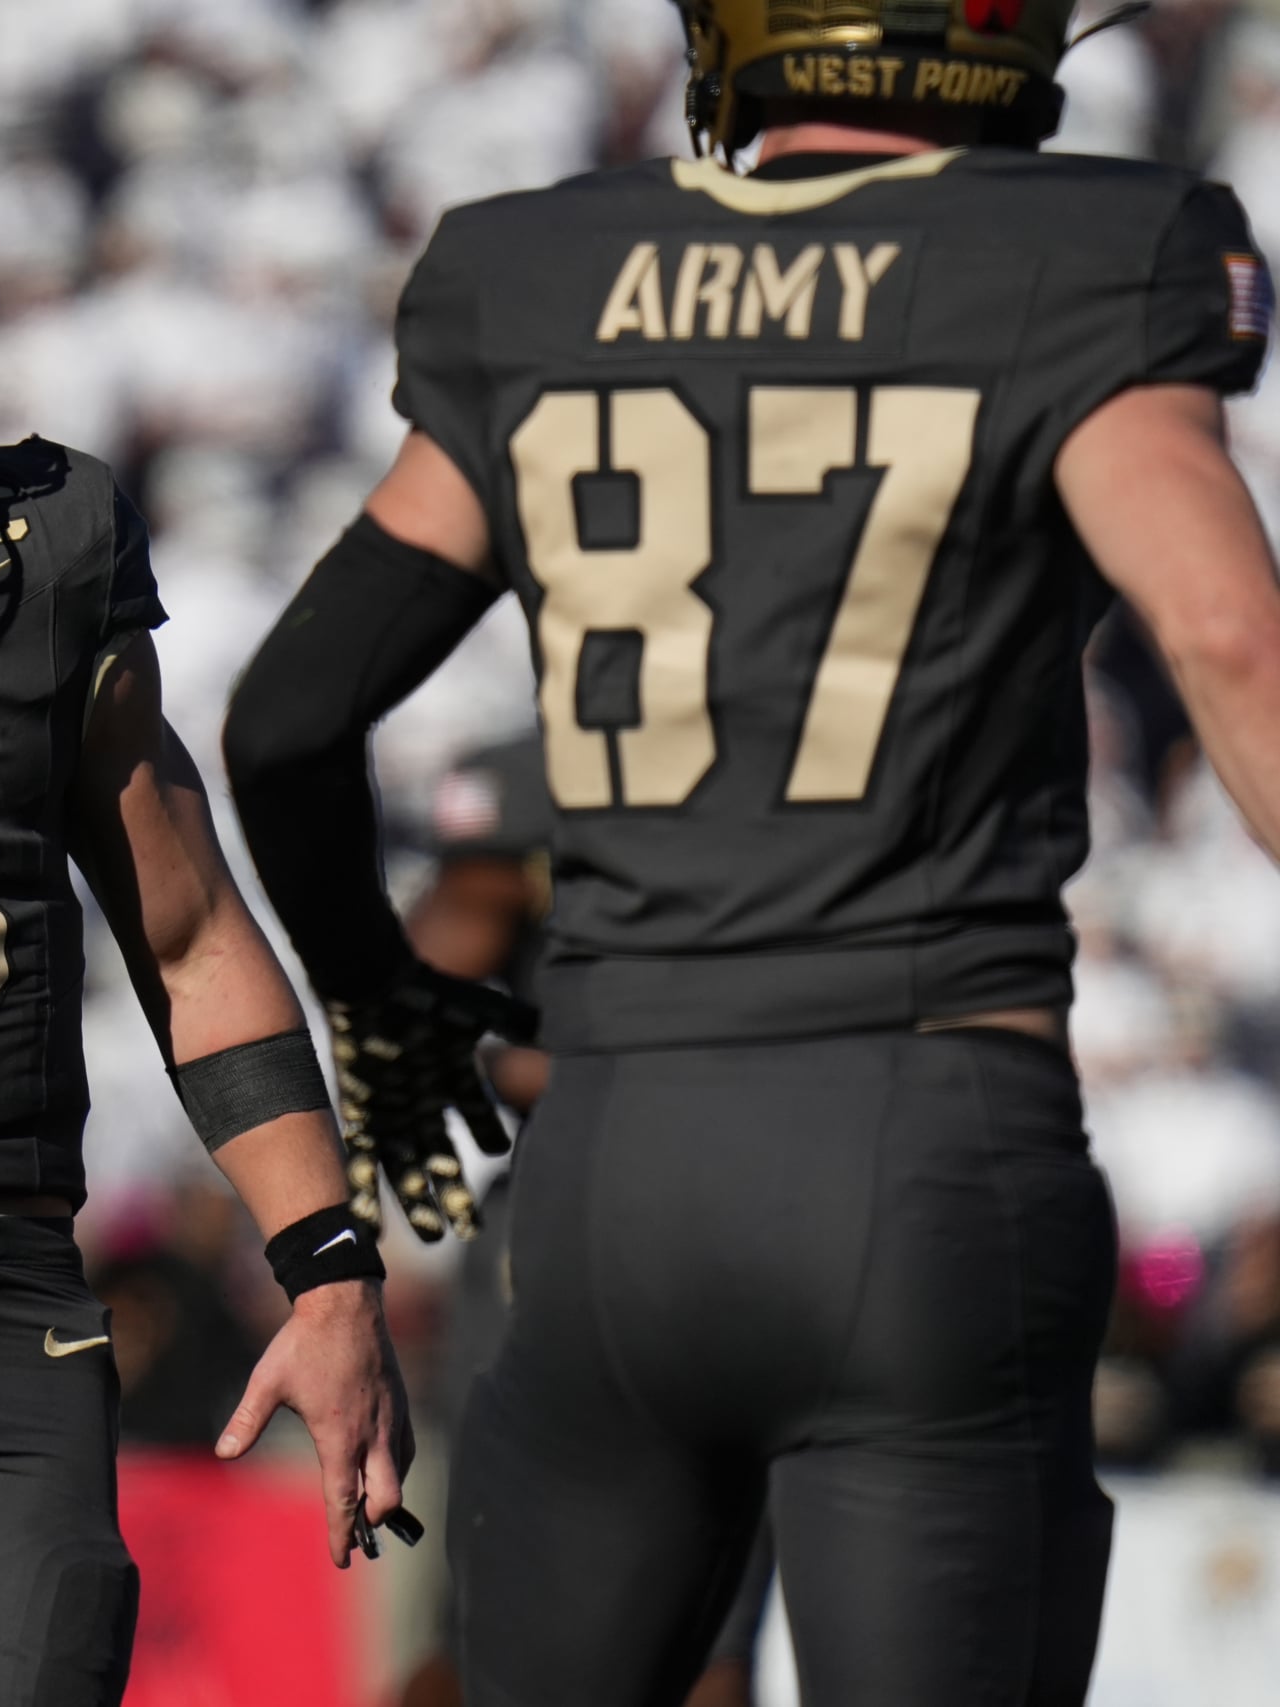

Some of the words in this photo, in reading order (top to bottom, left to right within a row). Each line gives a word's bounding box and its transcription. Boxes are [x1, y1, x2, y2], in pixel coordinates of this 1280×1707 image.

[783, 53, 904, 98] WEST
[911, 57, 1028, 105] POINT
[595, 241, 901, 342] ARMY
[508, 384, 981, 809] 87
